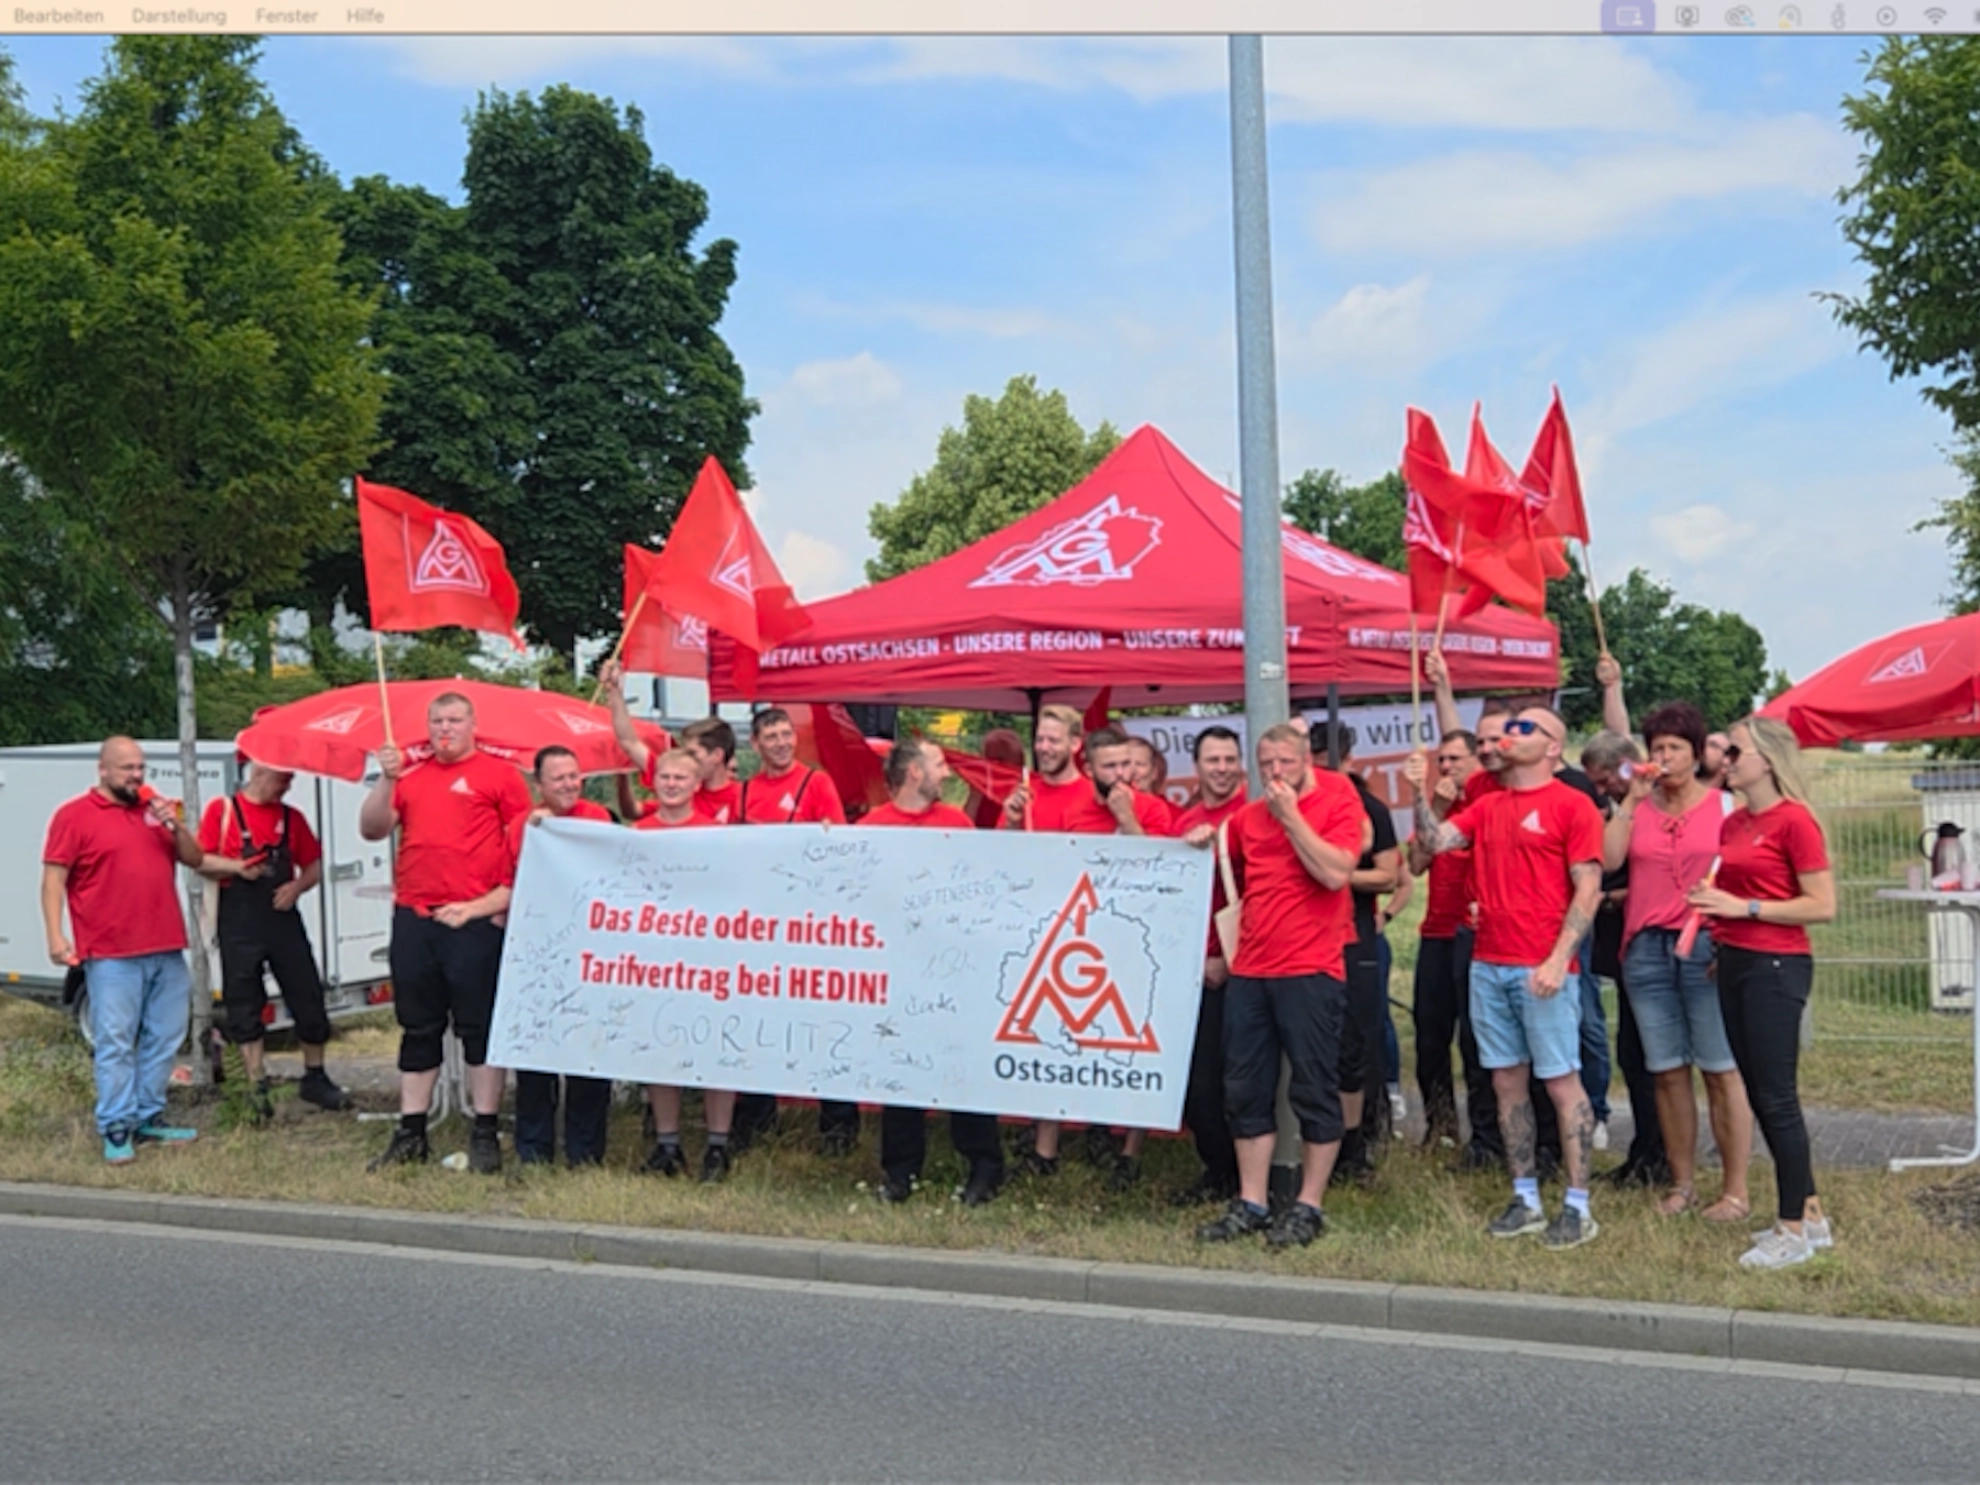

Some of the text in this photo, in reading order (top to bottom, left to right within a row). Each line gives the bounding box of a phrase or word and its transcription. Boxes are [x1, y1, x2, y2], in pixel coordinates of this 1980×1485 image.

[822, 637, 940, 663] OSTSACHSEN
[954, 631, 1026, 654] UNSERE
[1030, 630, 1103, 650] REGION
[1123, 629, 1202, 648] UNSERE
[1366, 713, 1435, 745] wird
[589, 900, 632, 932] Das
[637, 904, 707, 937] Beste
[714, 909, 778, 943] oder
[786, 912, 884, 949] nichts.
[581, 952, 889, 1004] Tarifvertrag bei HEDIN!
[994, 1053, 1163, 1091] Ostsachsen
